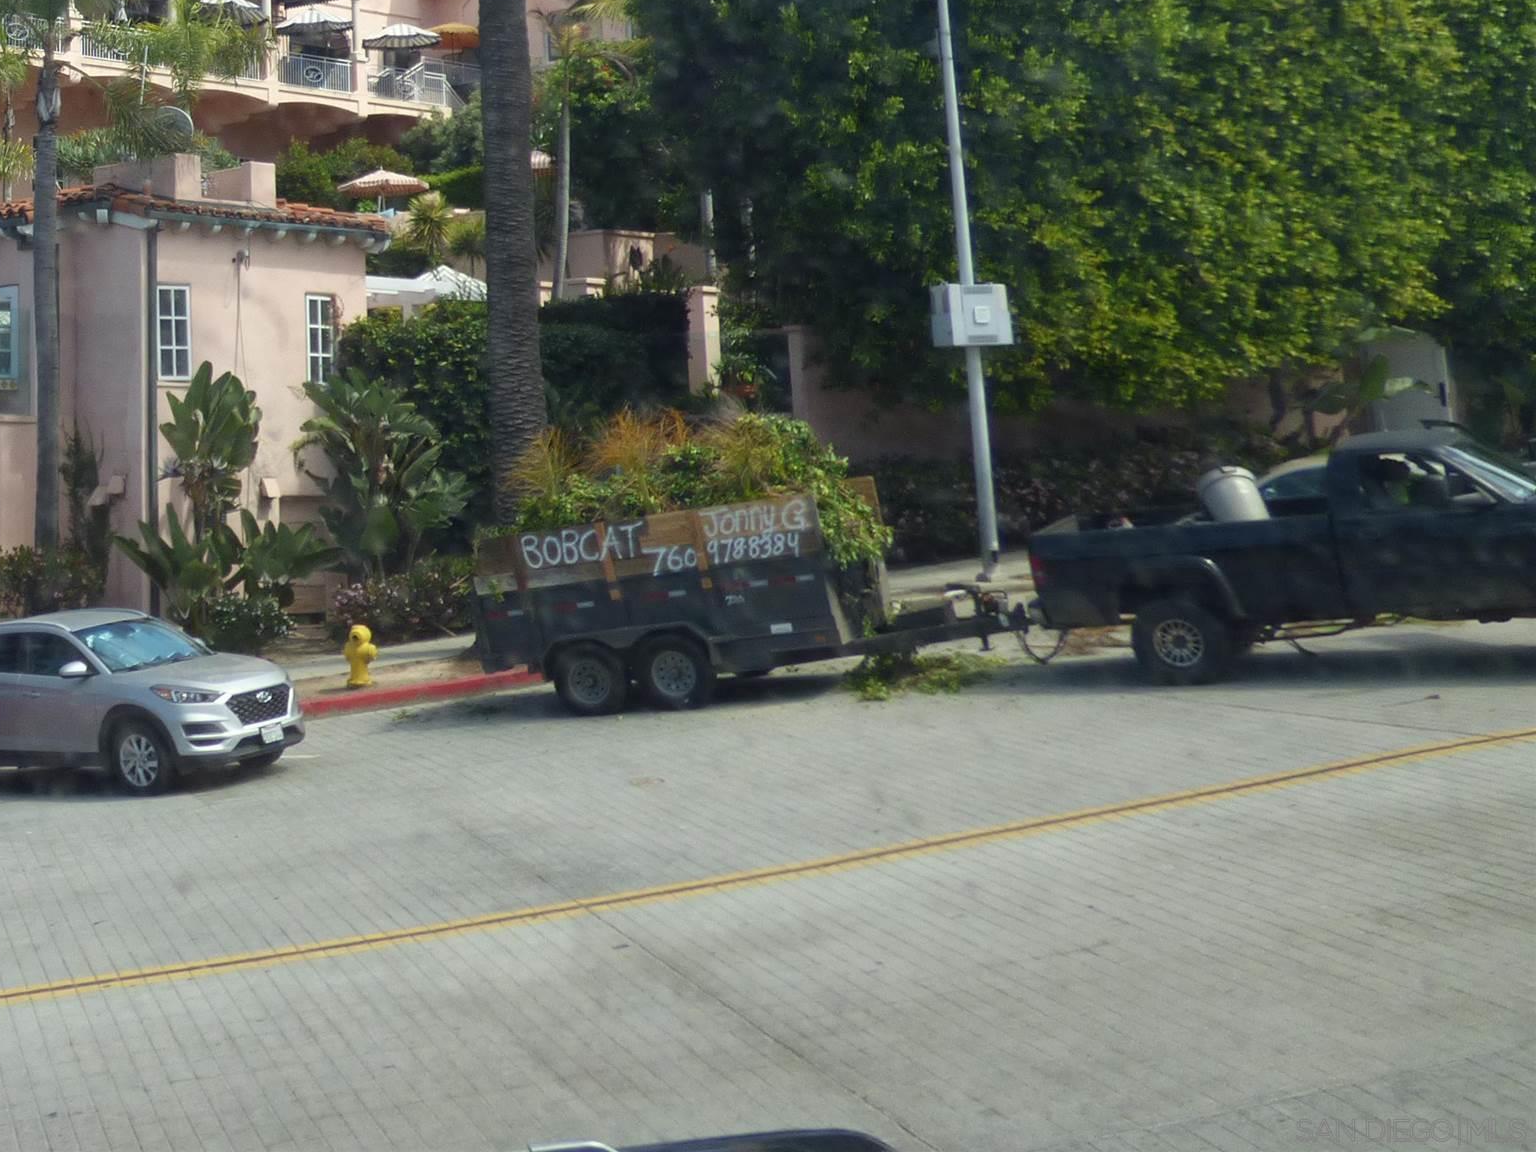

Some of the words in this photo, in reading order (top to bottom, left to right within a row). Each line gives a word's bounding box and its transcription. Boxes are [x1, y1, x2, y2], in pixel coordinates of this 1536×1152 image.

[781, 499, 806, 530] G
[520, 521, 643, 569] BOBCAT
[641, 545, 698, 577] 760
